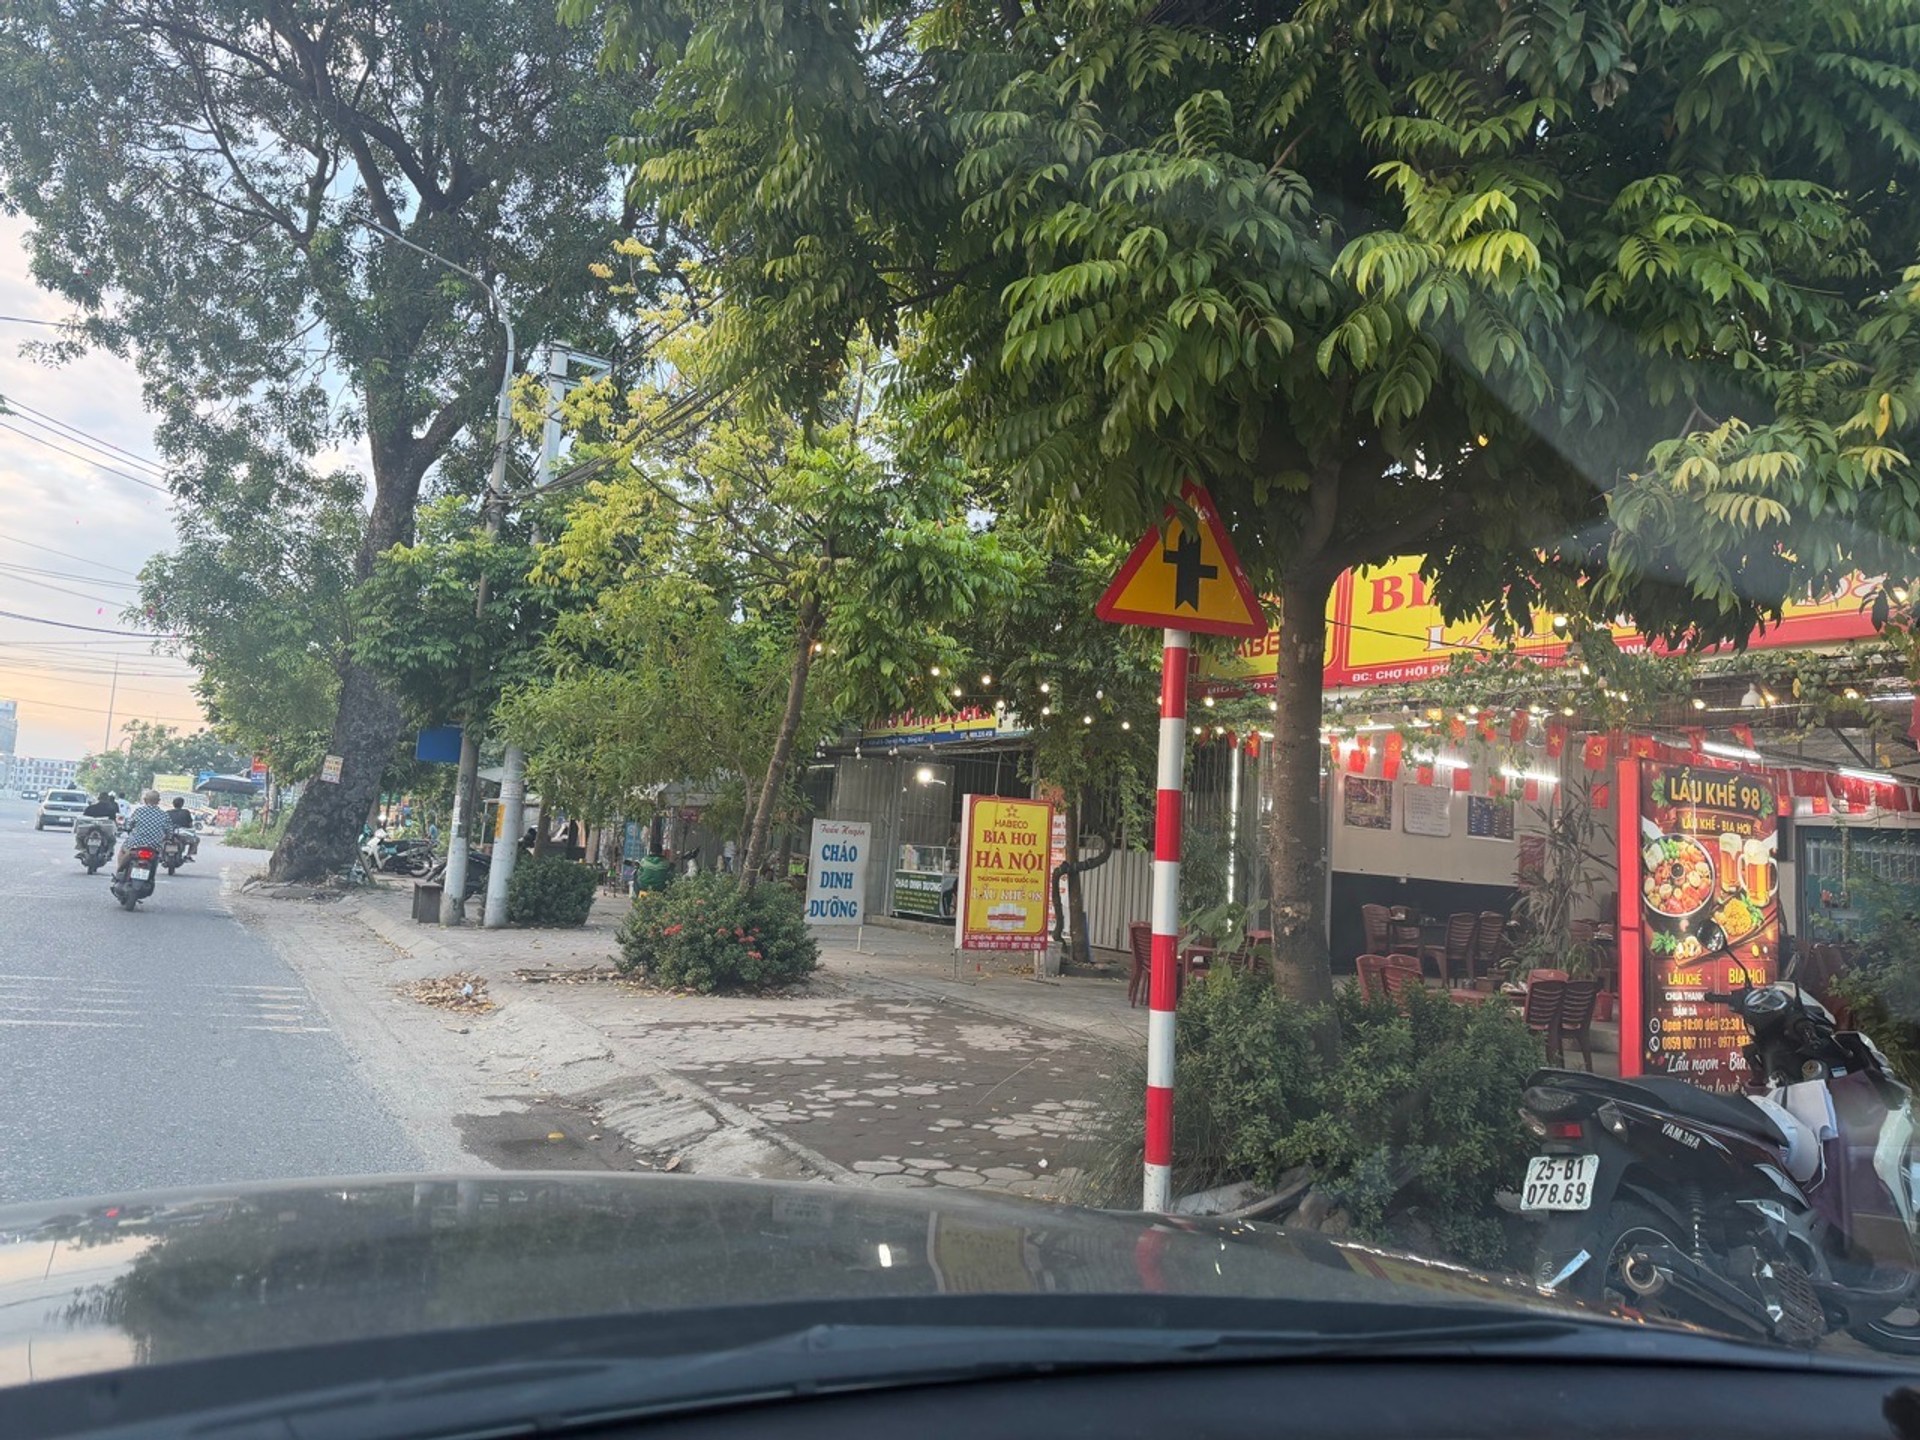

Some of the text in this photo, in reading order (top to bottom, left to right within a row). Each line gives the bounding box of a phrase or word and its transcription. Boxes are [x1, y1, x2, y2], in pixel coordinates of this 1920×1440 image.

[1375, 668, 1403, 680] CHỢ
[1405, 665, 1429, 677] HỘI
[1431, 664, 1450, 675] PH
[1670, 766, 1761, 811] LẨU KHẾ 98
[994, 818, 1029, 830] HABECO
[1700, 815, 1716, 831] KHẾ
[1722, 820, 1735, 832] BIA
[983, 829, 1007, 844] BIA
[822, 840, 858, 862] CHÁO
[975, 847, 1044, 874] HÀ NỘI
[819, 871, 854, 890] DINH
[809, 895, 858, 918] DƯỠNG
[1698, 1036, 1712, 1049] 111
[1691, 1058, 1719, 1076] ngon
[1535, 1158, 1585, 1181] 25-B1
[1527, 1181, 1587, 1206] 078.69
